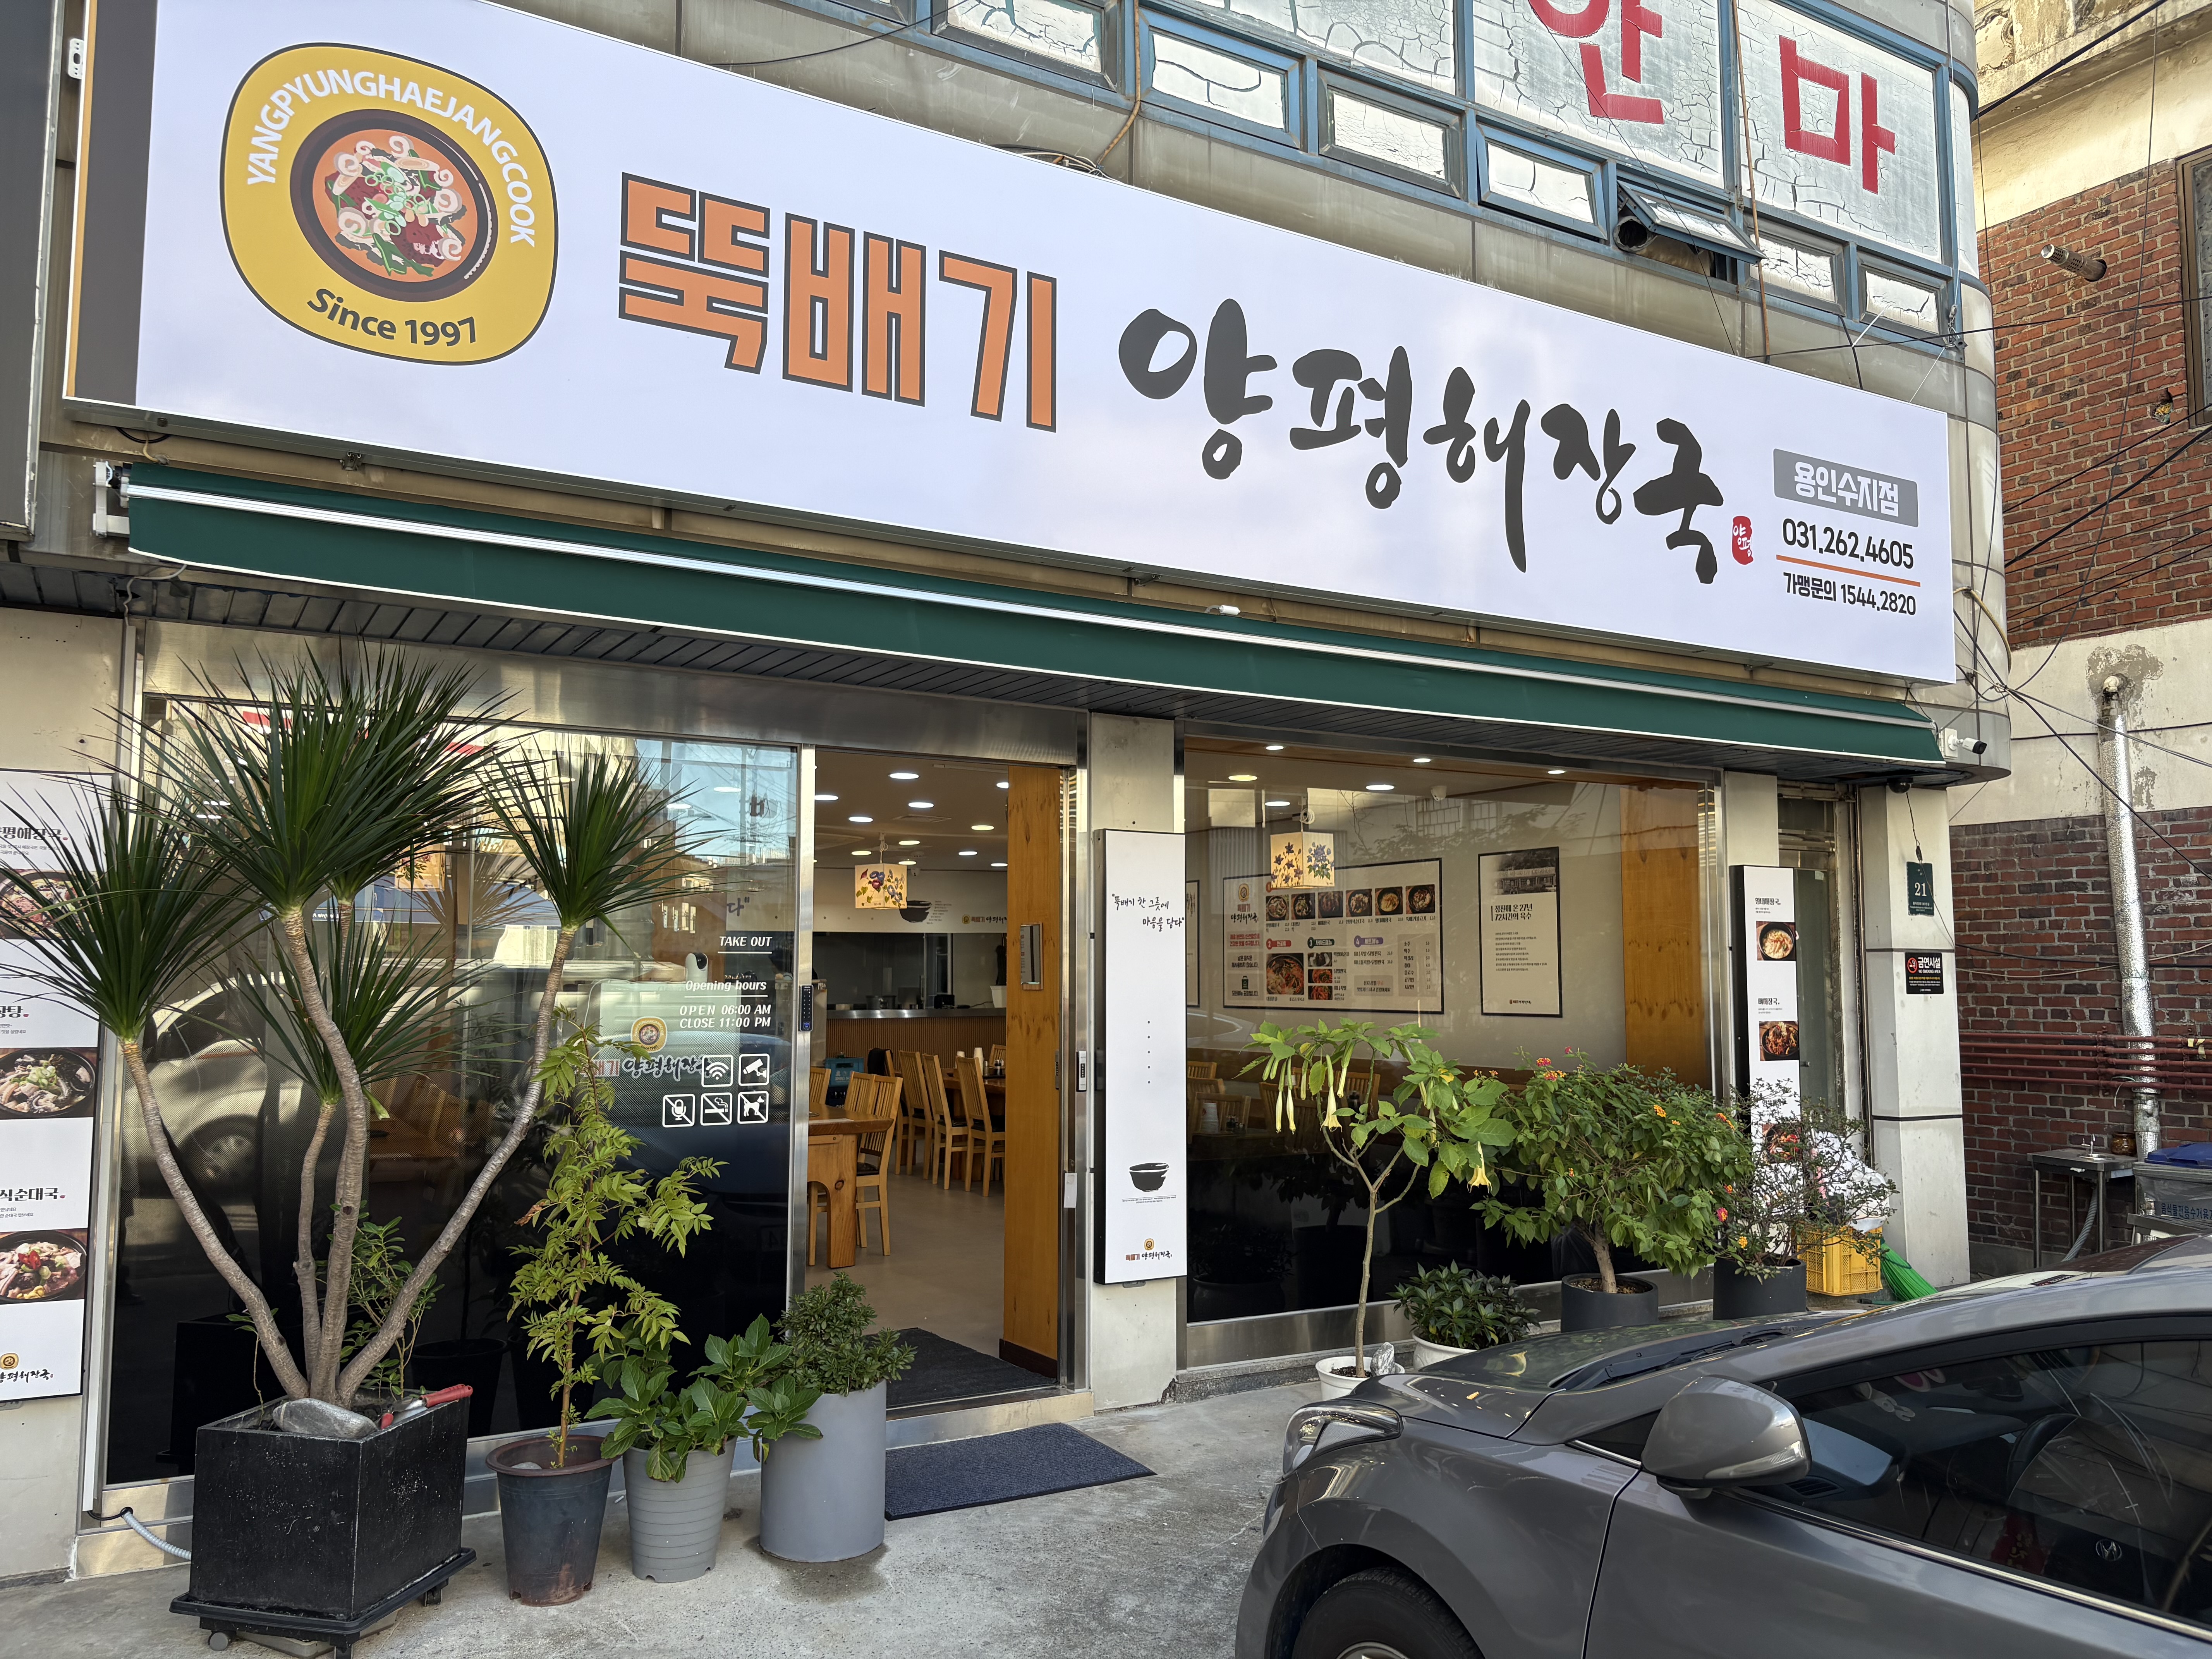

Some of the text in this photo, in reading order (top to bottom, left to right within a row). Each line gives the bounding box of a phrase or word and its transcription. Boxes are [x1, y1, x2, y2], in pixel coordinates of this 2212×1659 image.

[247, 69, 535, 247] YANGPYUNGHAEJANGCOOK
[618, 172, 1057, 433] 뚝배기
[307, 287, 477, 347] Since 1997
[1118, 298, 1724, 584] 양평해장국
[1794, 461, 1899, 517] 용인수지점
[1783, 518, 1913, 569] 031.262.4605
[1783, 572, 1916, 615] 가맹문의 1544.2820
[0, 827, 62, 840] 평해장국
[1914, 882, 1927, 896] 21
[1138, 897, 1146, 908] 한
[1149, 896, 1169, 910] 그릇에
[1495, 912, 1518, 921] 72시간의
[1143, 916, 1163, 932] 마음을
[720, 936, 773, 946] TAKE OUT
[1917, 957, 1941, 969] 금연시설
[686, 980, 767, 991] Opening hours
[680, 1005, 771, 1015] OPEN 06:00 AM
[680, 1017, 771, 1028] CLOSE 11:00 PM
